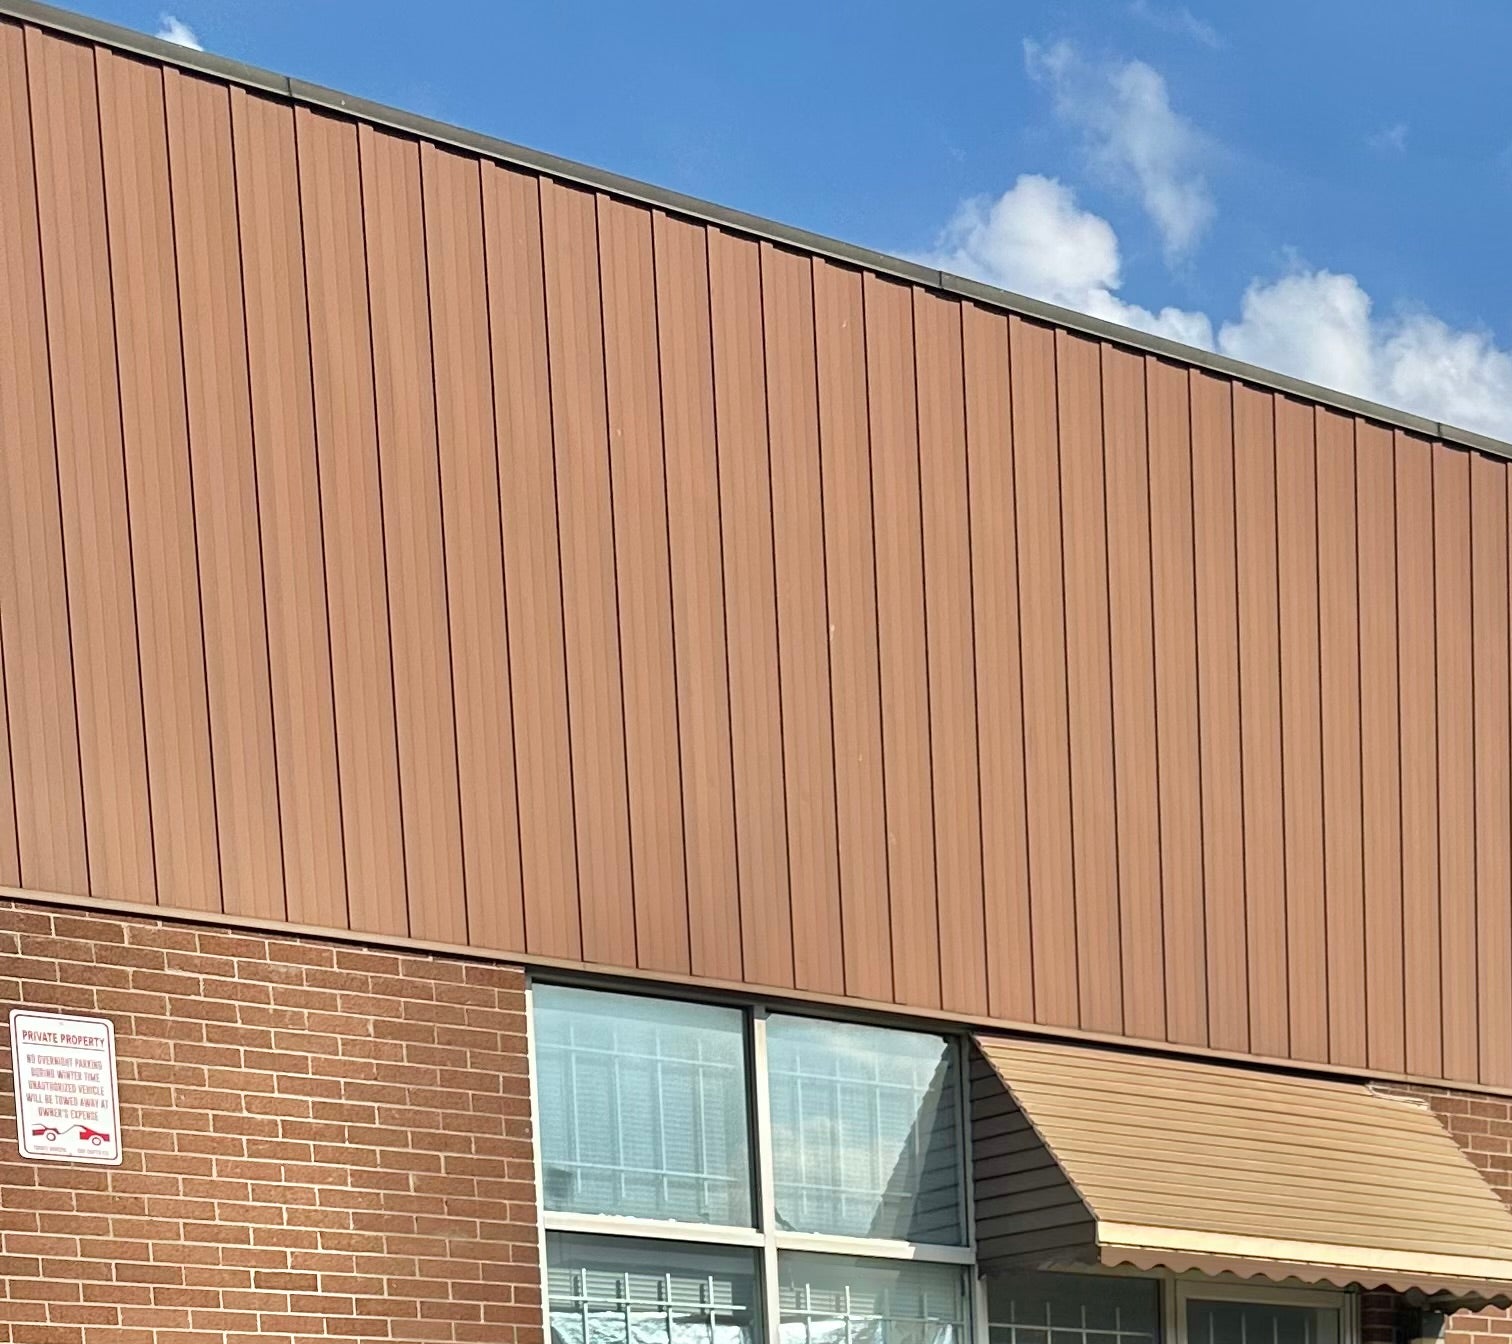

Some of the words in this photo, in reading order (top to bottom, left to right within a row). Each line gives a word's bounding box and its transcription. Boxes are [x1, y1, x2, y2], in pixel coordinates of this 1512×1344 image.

[22, 1030, 58, 1044] PRIVATE
[60, 1034, 105, 1048] PROPERTY
[37, 1054, 73, 1068] OVERNIGHT
[75, 1058, 103, 1070] PARKING
[57, 1069, 82, 1081] WINTER
[84, 1071, 101, 1083] TIME
[26, 1093, 43, 1103] WILL
[45, 1095, 54, 1105] BE
[55, 1095, 78, 1107] TOWED
[80, 1098, 98, 1109] AWAY
[101, 1099, 108, 1109] AT
[38, 1107, 69, 1119] OWNER'S
[70, 1109, 98, 1121] EXPENSE
